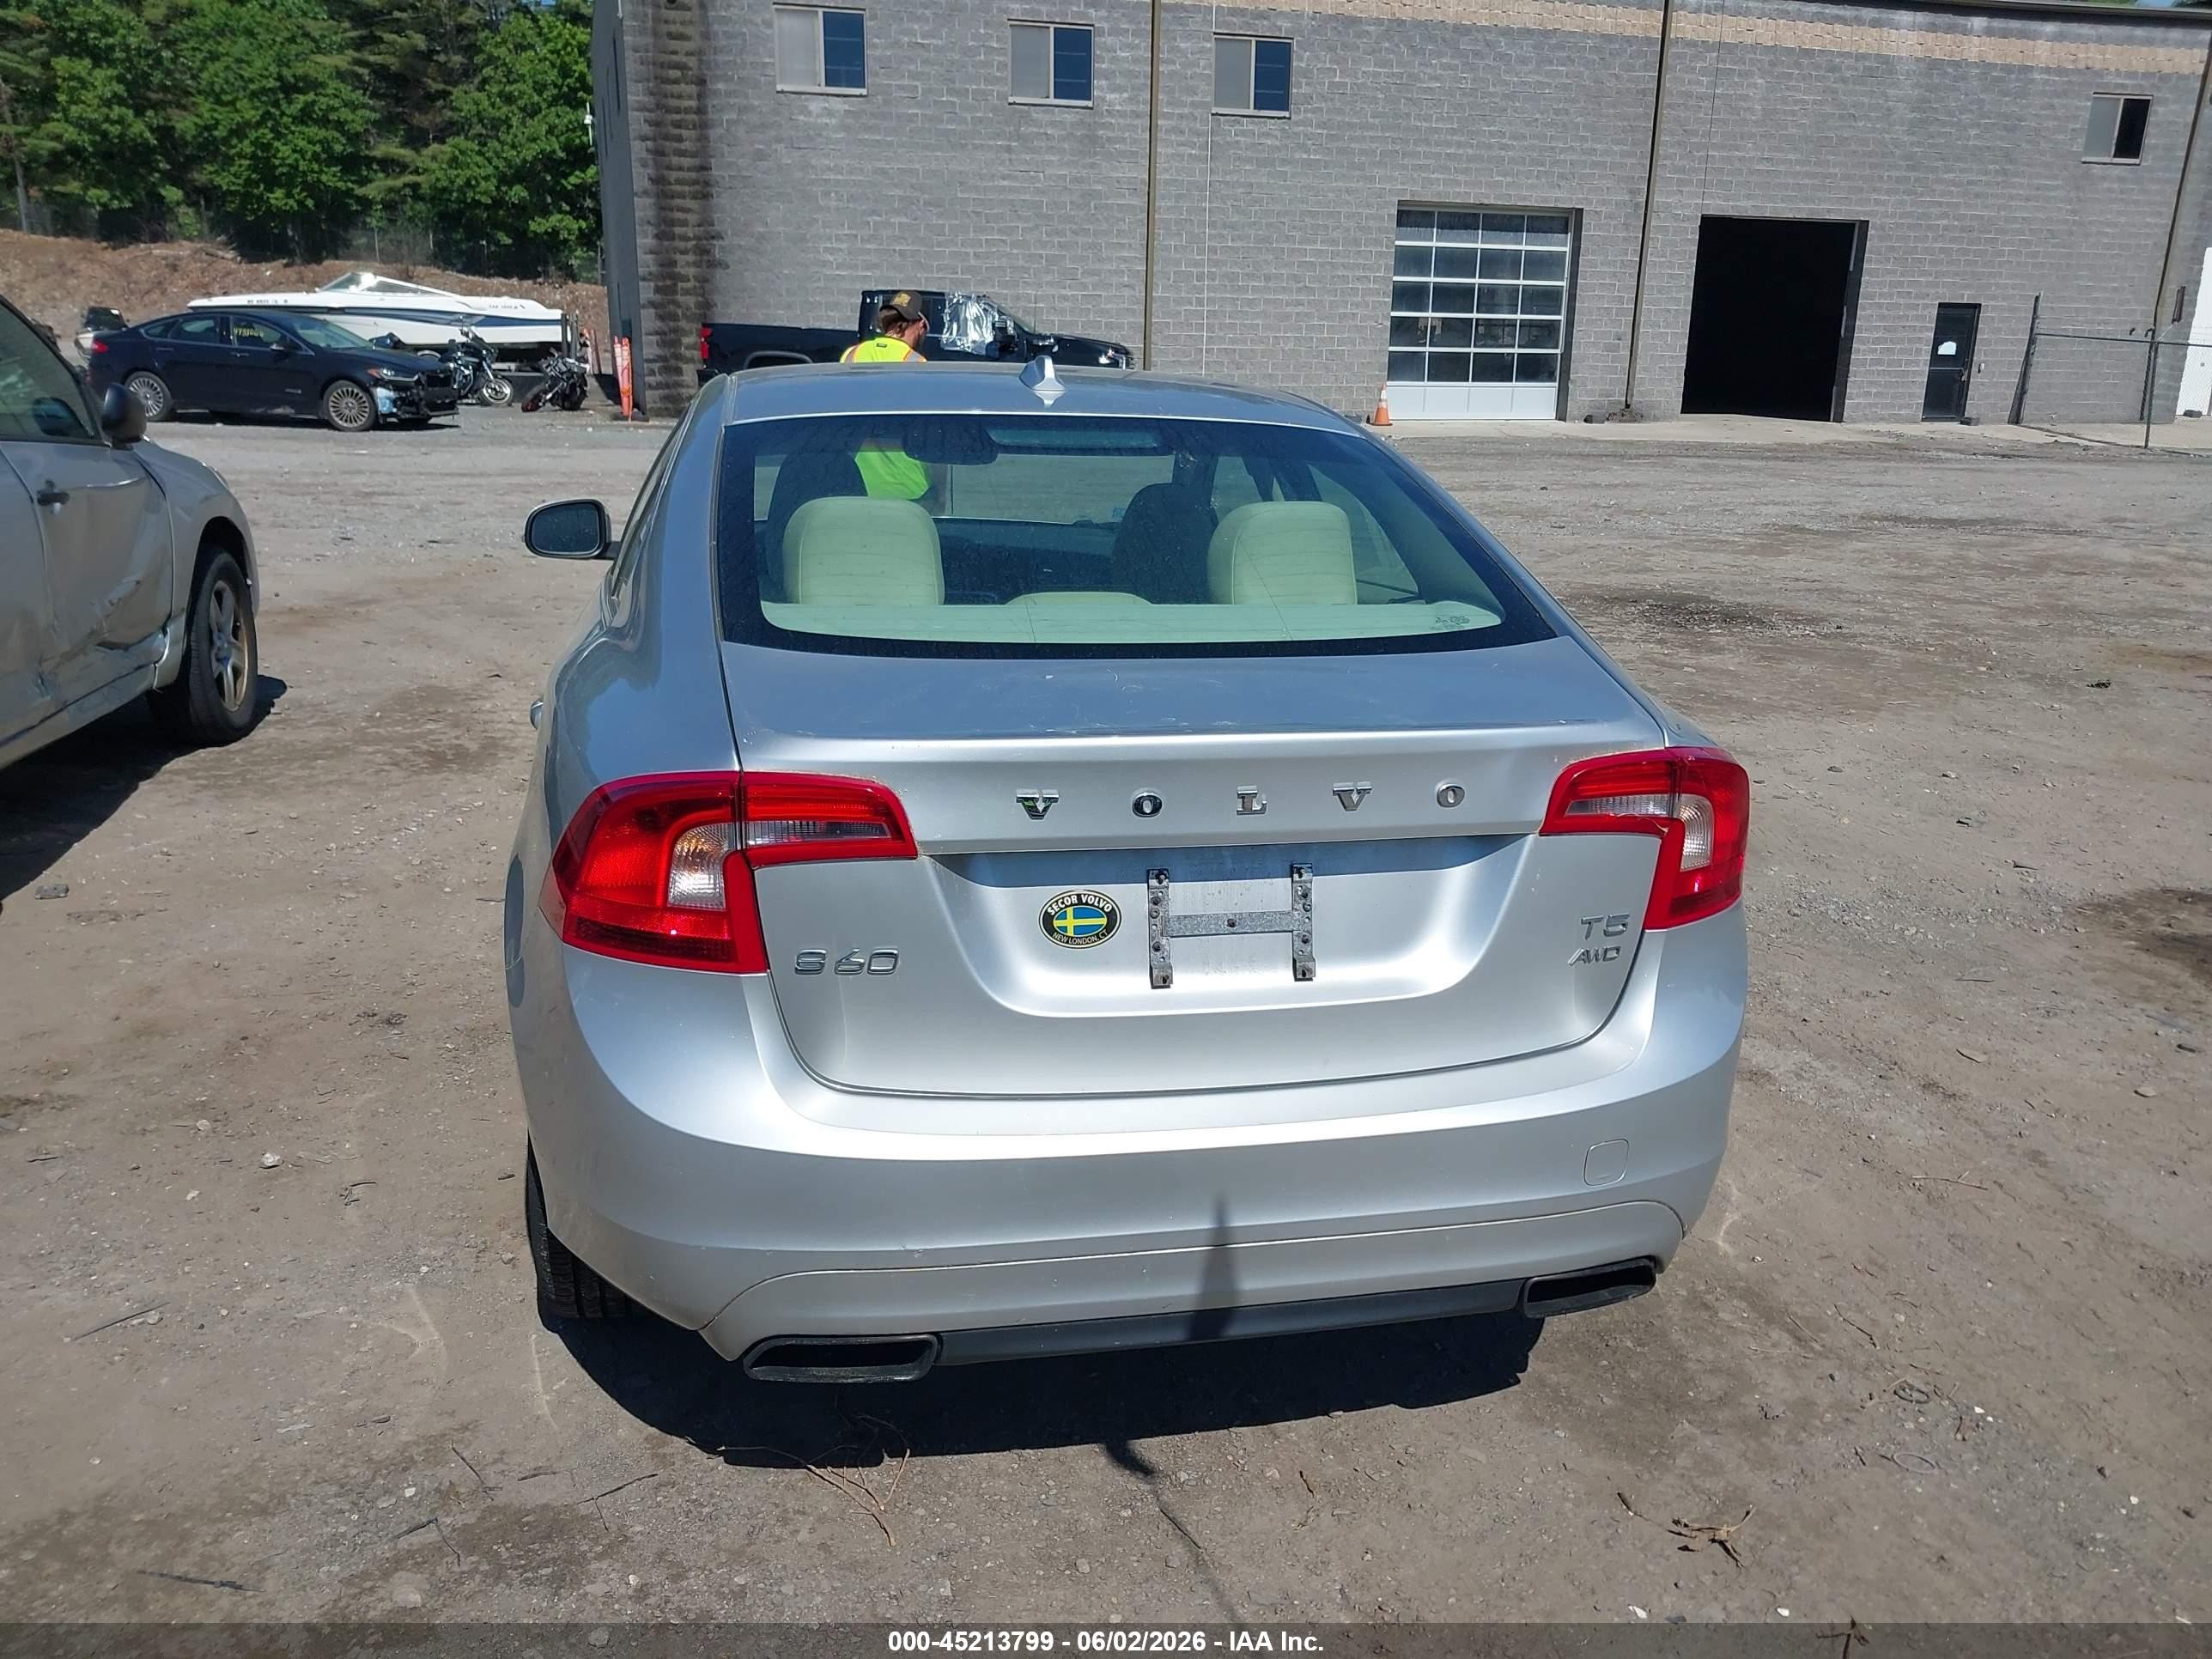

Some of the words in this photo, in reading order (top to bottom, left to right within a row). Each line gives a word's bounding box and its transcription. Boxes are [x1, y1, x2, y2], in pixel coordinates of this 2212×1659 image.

[1016, 782, 1466, 821] VOLVO
[1048, 895, 1078, 915] SECOR
[1081, 894, 1112, 912] VOLVO
[1053, 933, 1069, 942] NEW
[1100, 930, 1108, 939] CT
[1581, 914, 1630, 939] T5
[795, 949, 899, 975] S60
[1568, 945, 1621, 966] AWD
